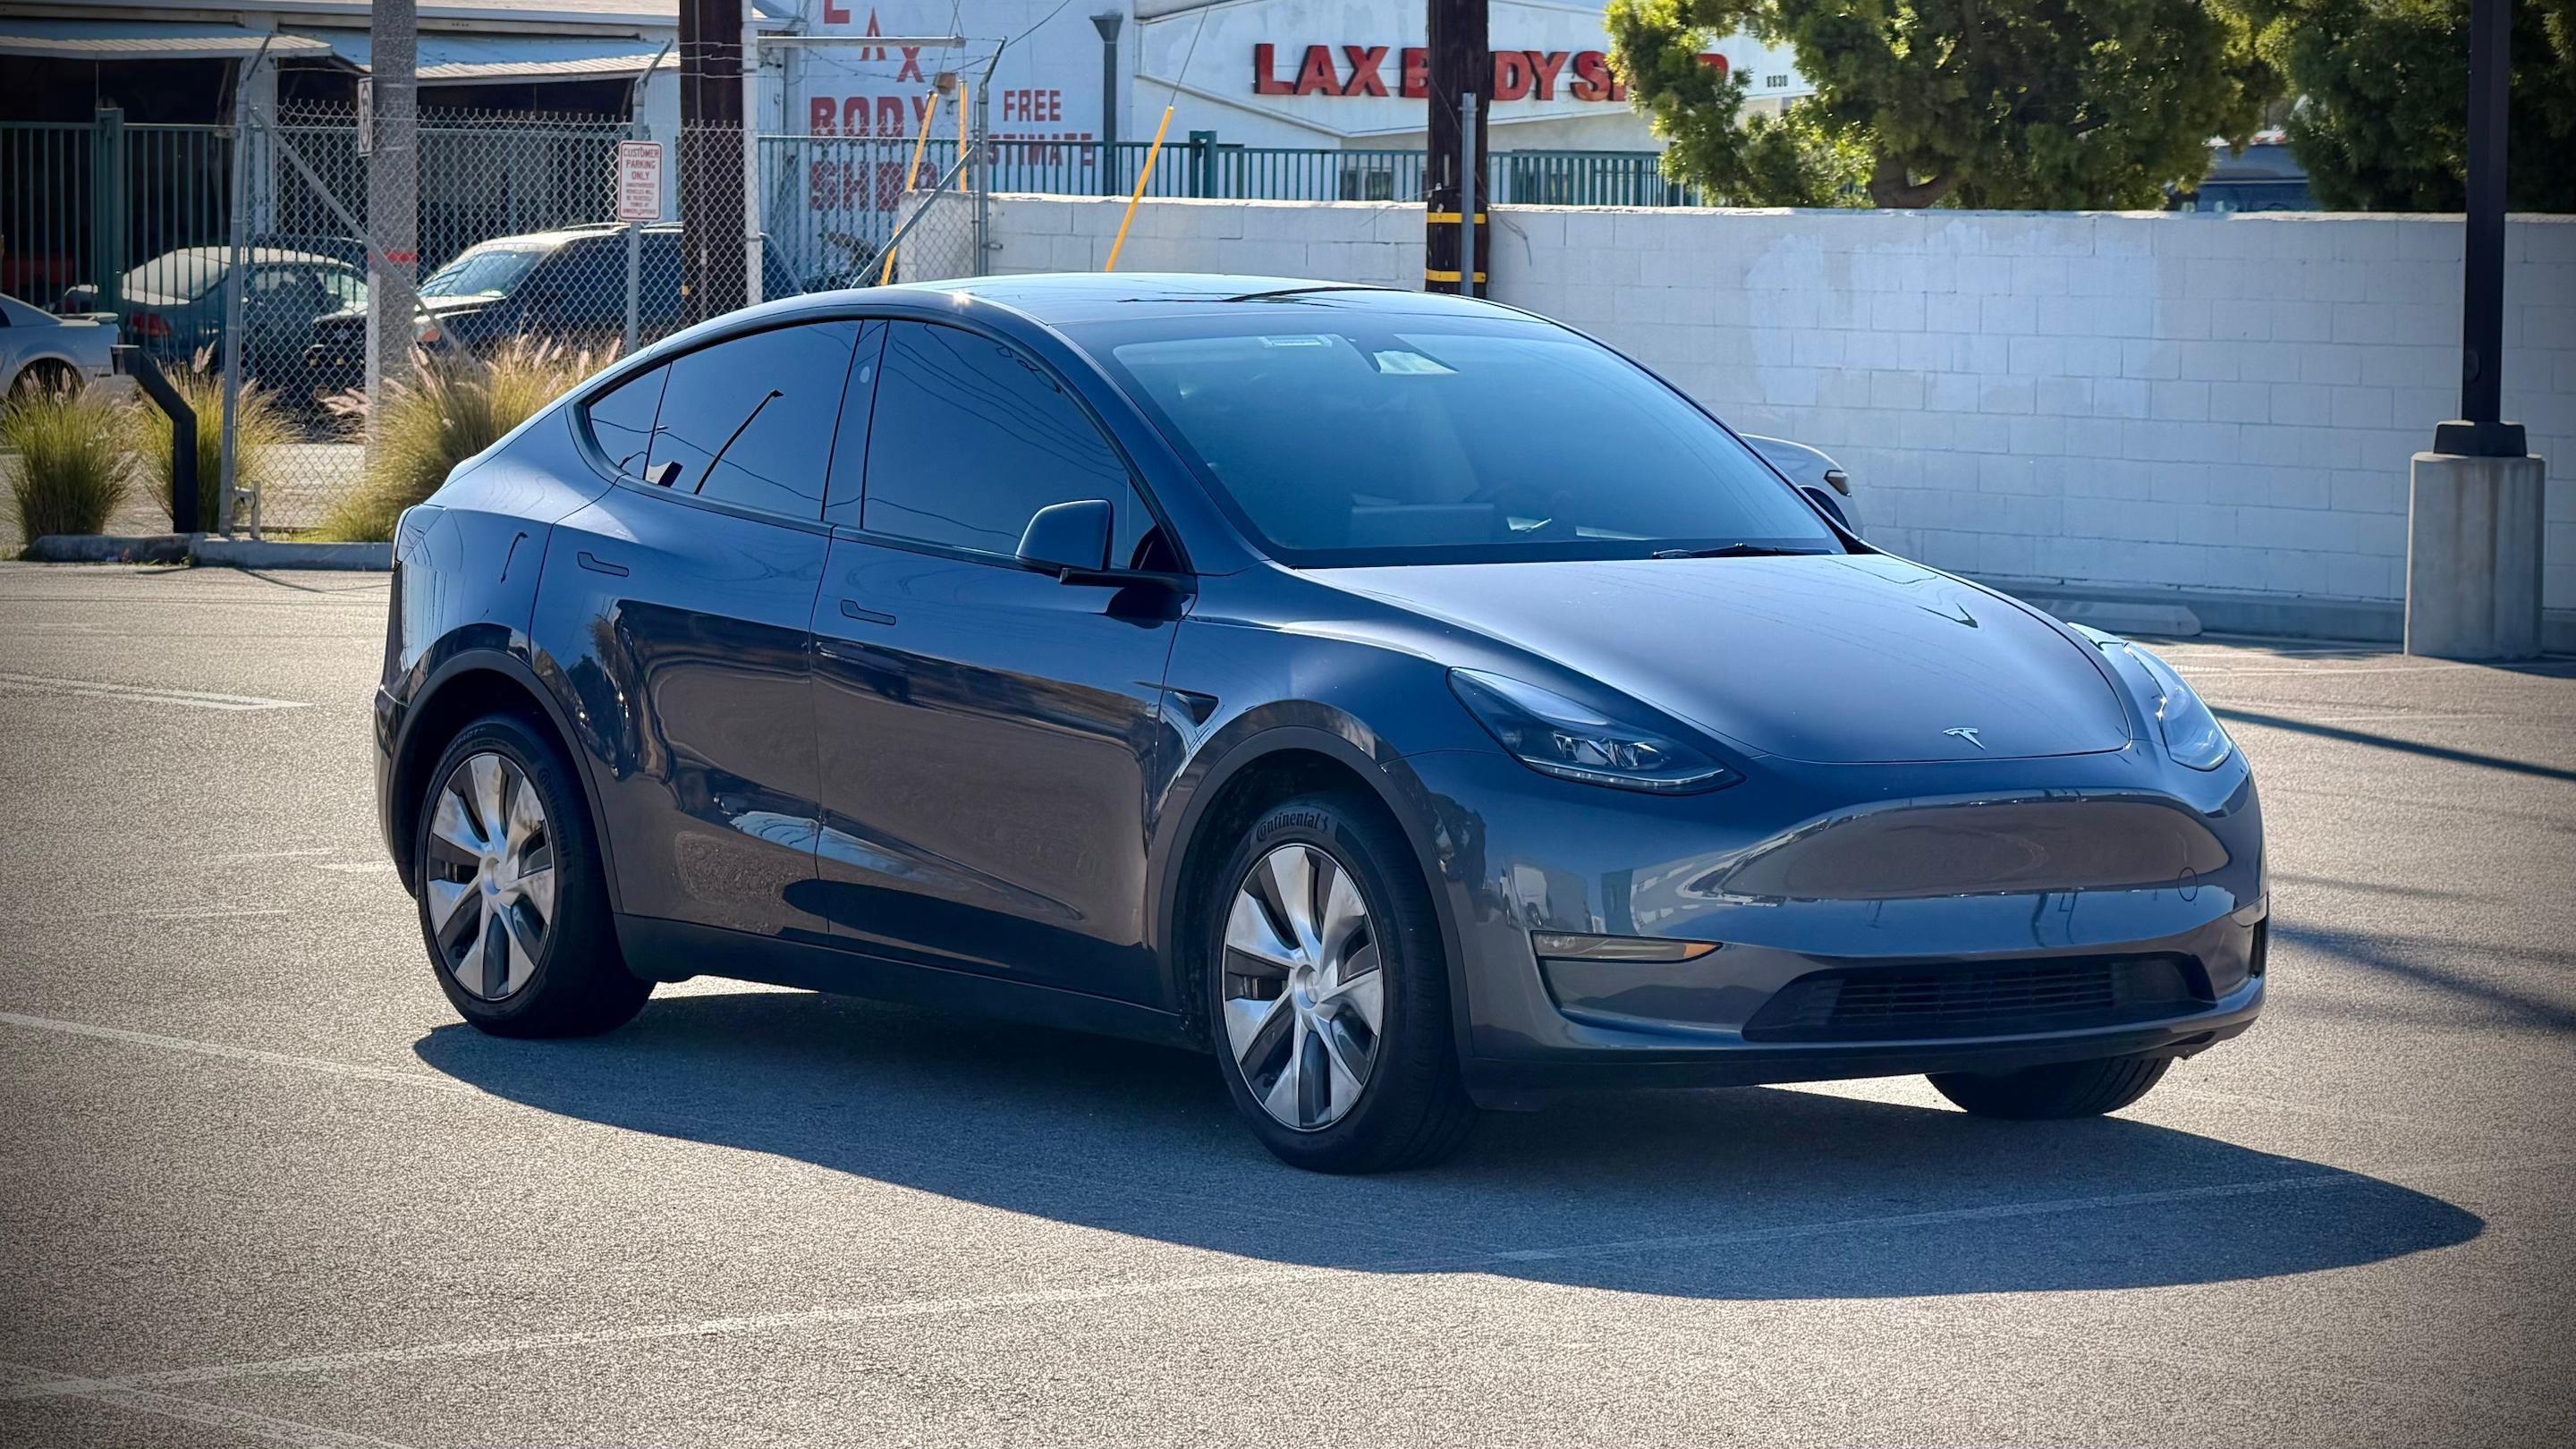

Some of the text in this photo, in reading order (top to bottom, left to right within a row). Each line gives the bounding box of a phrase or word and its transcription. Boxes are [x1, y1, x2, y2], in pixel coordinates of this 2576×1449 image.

[1254, 43, 1389, 96] LAX
[1400, 47, 1571, 101] BDY
[1004, 89, 1062, 122] FREE
[623, 147, 659, 157] CUSTOMER
[626, 159, 656, 169] PARKING
[973, 133, 1093, 166] STIMAE
[631, 171, 649, 180] ONLY
[1256, 812, 1320, 843] Continental
